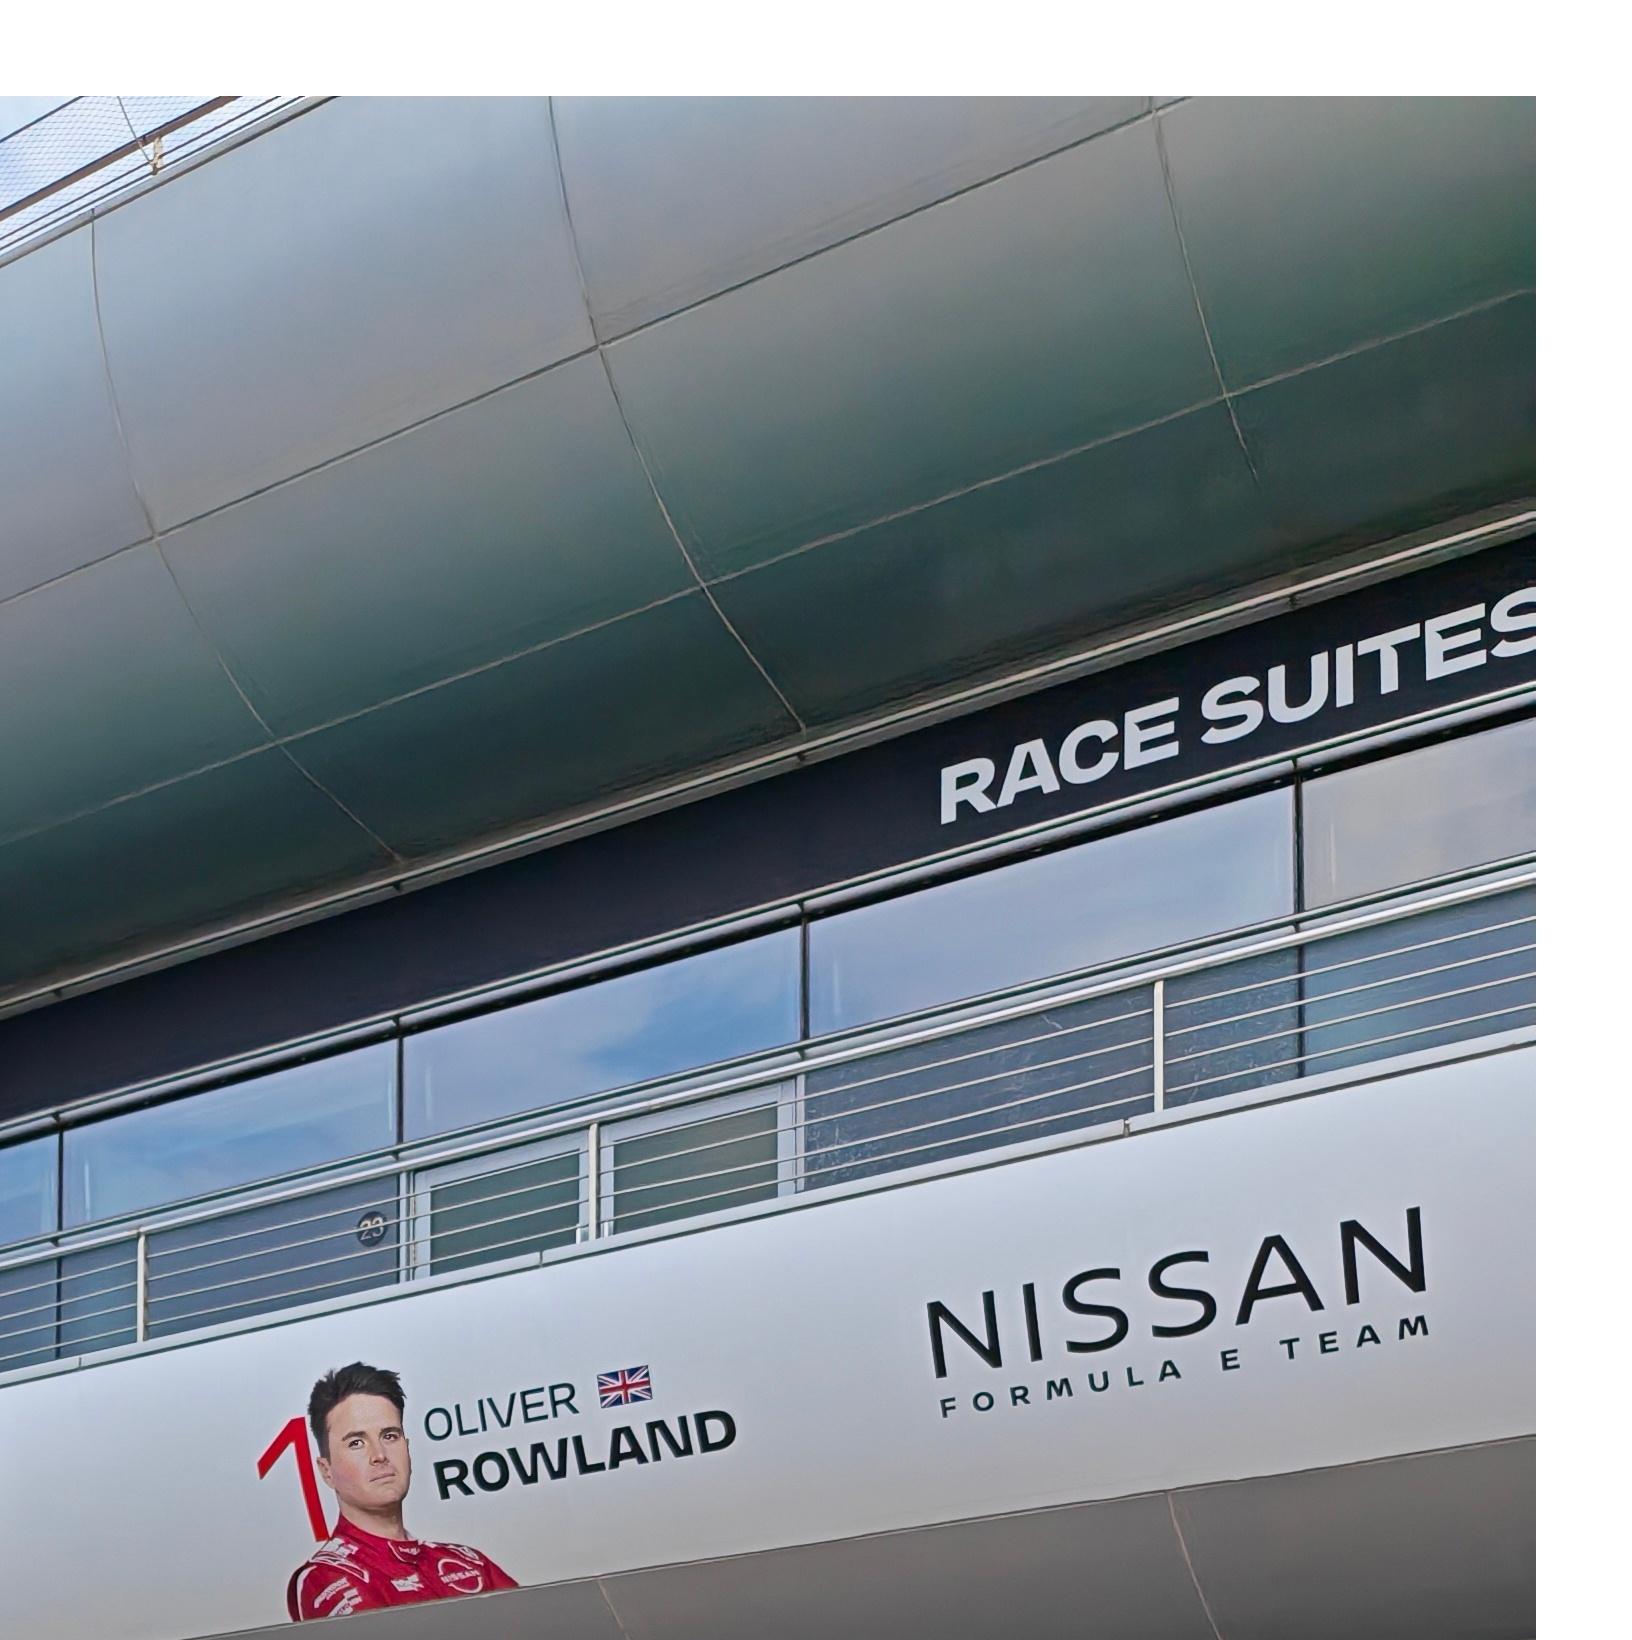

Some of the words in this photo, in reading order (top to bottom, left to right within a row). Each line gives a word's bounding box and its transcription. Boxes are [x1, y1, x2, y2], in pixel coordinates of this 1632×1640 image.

[940, 696, 1180, 826] RACE
[1200, 586, 1536, 746] SUITES
[926, 1206, 1427, 1379] NISSAN
[424, 1383, 580, 1442] OLIVER
[940, 1360, 1182, 1419] FORMULA
[1220, 1348, 1241, 1372] E
[1280, 1315, 1430, 1361] TEAM
[257, 1416, 330, 1543] 1
[433, 1410, 738, 1501] ROWLAND
